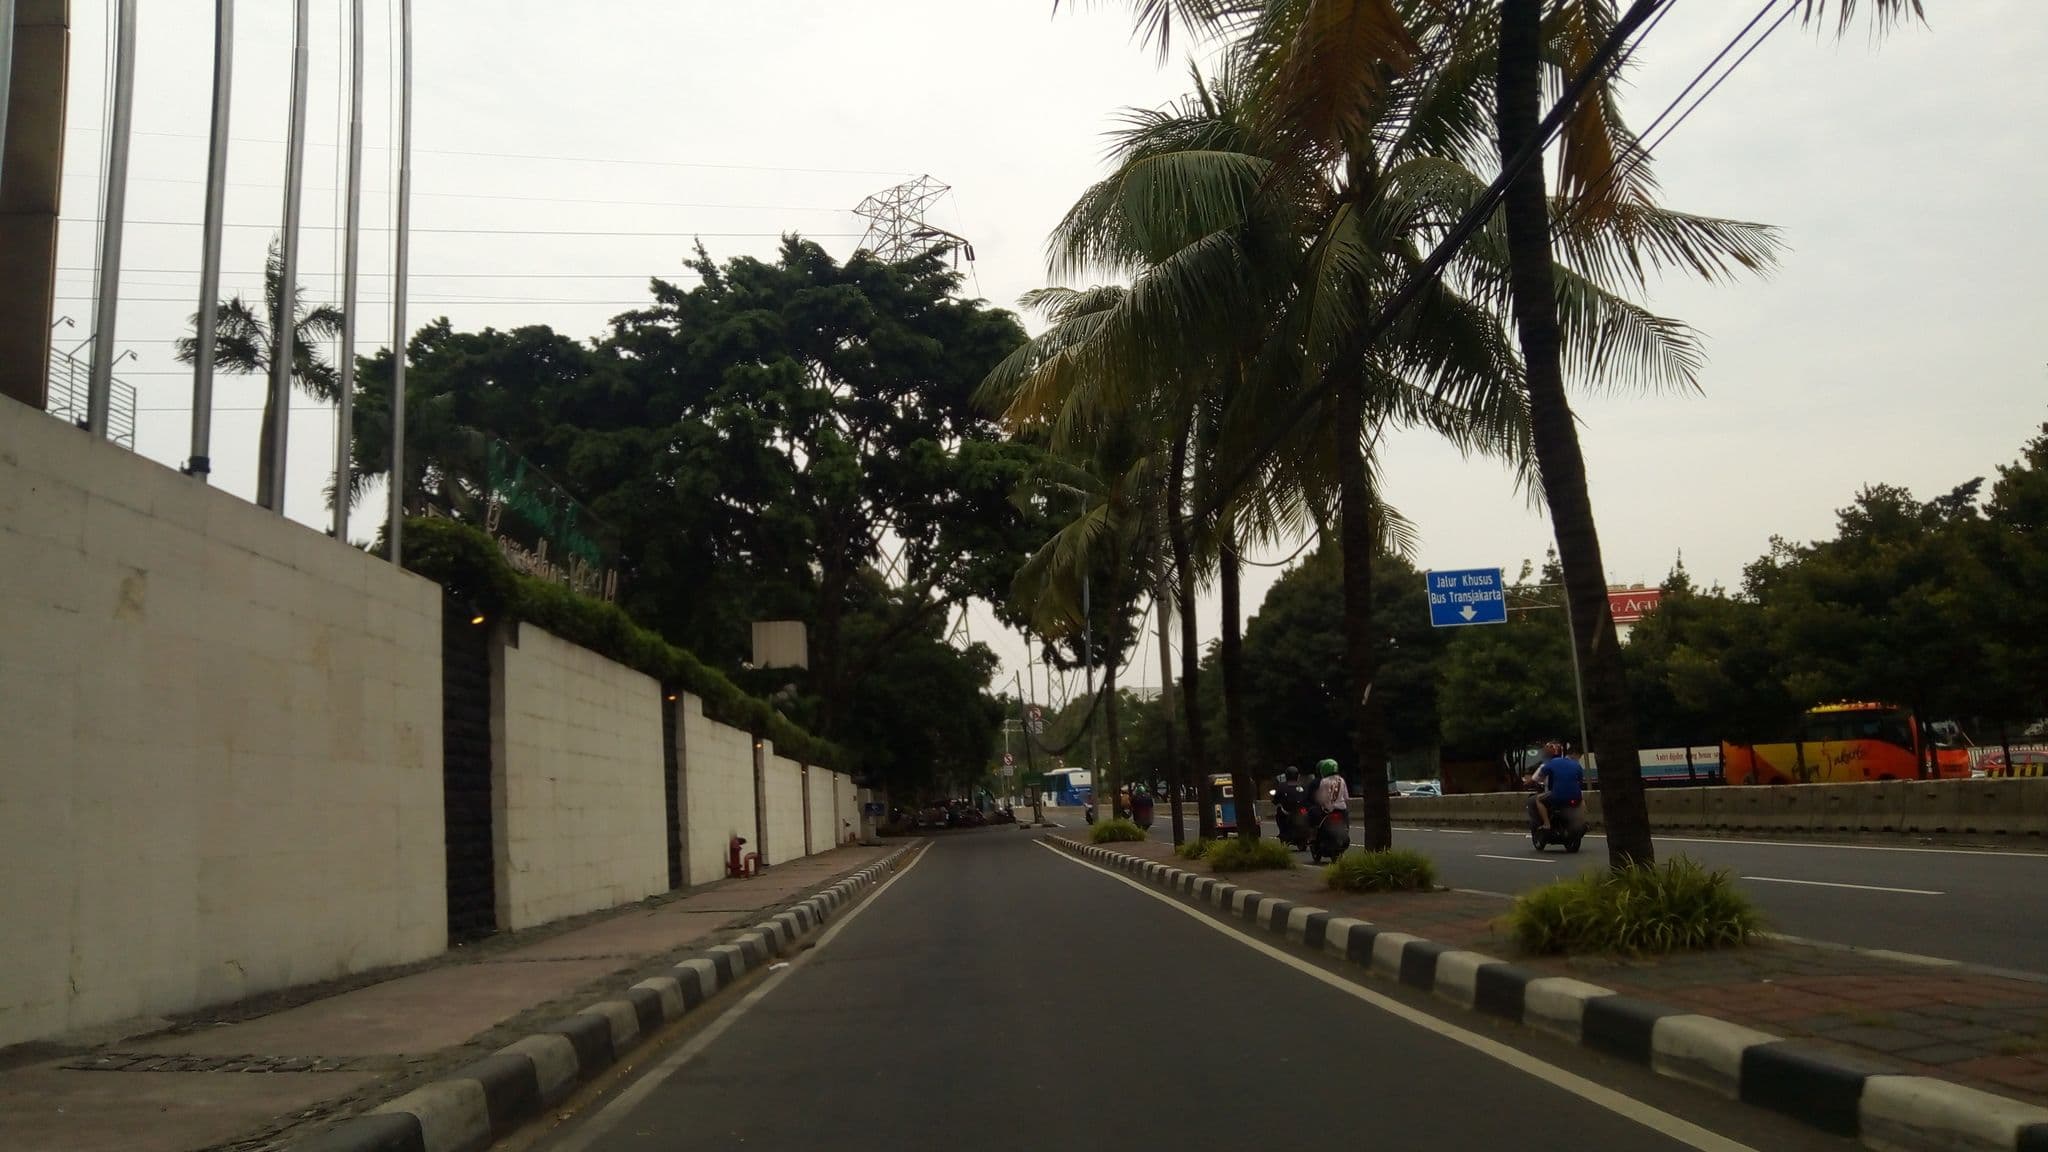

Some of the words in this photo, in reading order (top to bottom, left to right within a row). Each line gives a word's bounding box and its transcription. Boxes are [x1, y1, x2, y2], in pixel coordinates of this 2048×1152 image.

[1437, 576, 1457, 588] Jalur
[1462, 573, 1494, 587] Khusus
[1431, 592, 1447, 605] Bus
[1449, 589, 1502, 605] Transjakarta
